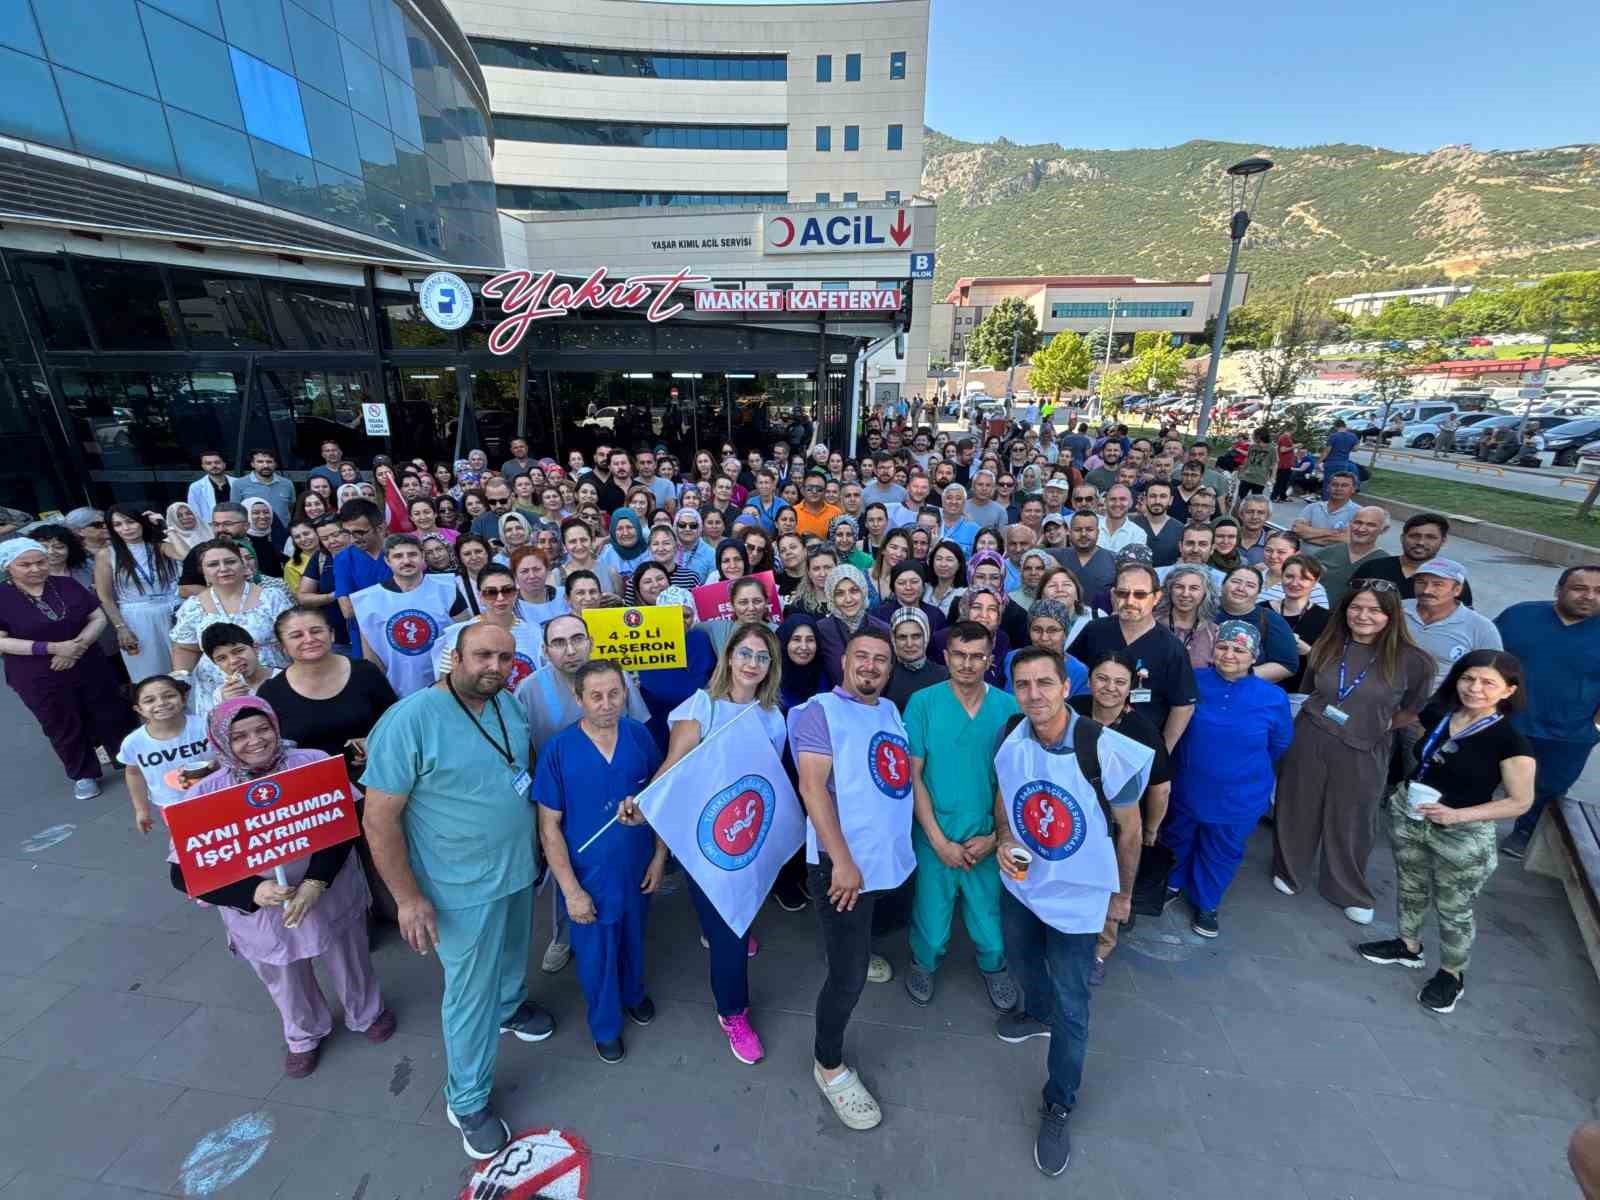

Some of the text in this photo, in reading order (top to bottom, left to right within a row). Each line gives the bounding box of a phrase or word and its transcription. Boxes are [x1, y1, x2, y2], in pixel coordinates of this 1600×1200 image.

[651, 240, 677, 252] YAŞAR
[916, 255, 929, 270] B
[698, 290, 897, 310] MARKET KAFETERYA
[608, 631, 619, 640] 4
[596, 641, 676, 656] TAŞERON
[607, 653, 677, 666] EĞİLDİR
[137, 738, 209, 768] LOVELY
[186, 823, 239, 852] AYNI
[244, 788, 346, 832] KURUMDA
[194, 808, 345, 868] İŞÇİ AYRIMINA
[246, 837, 311, 869] HAYIR
